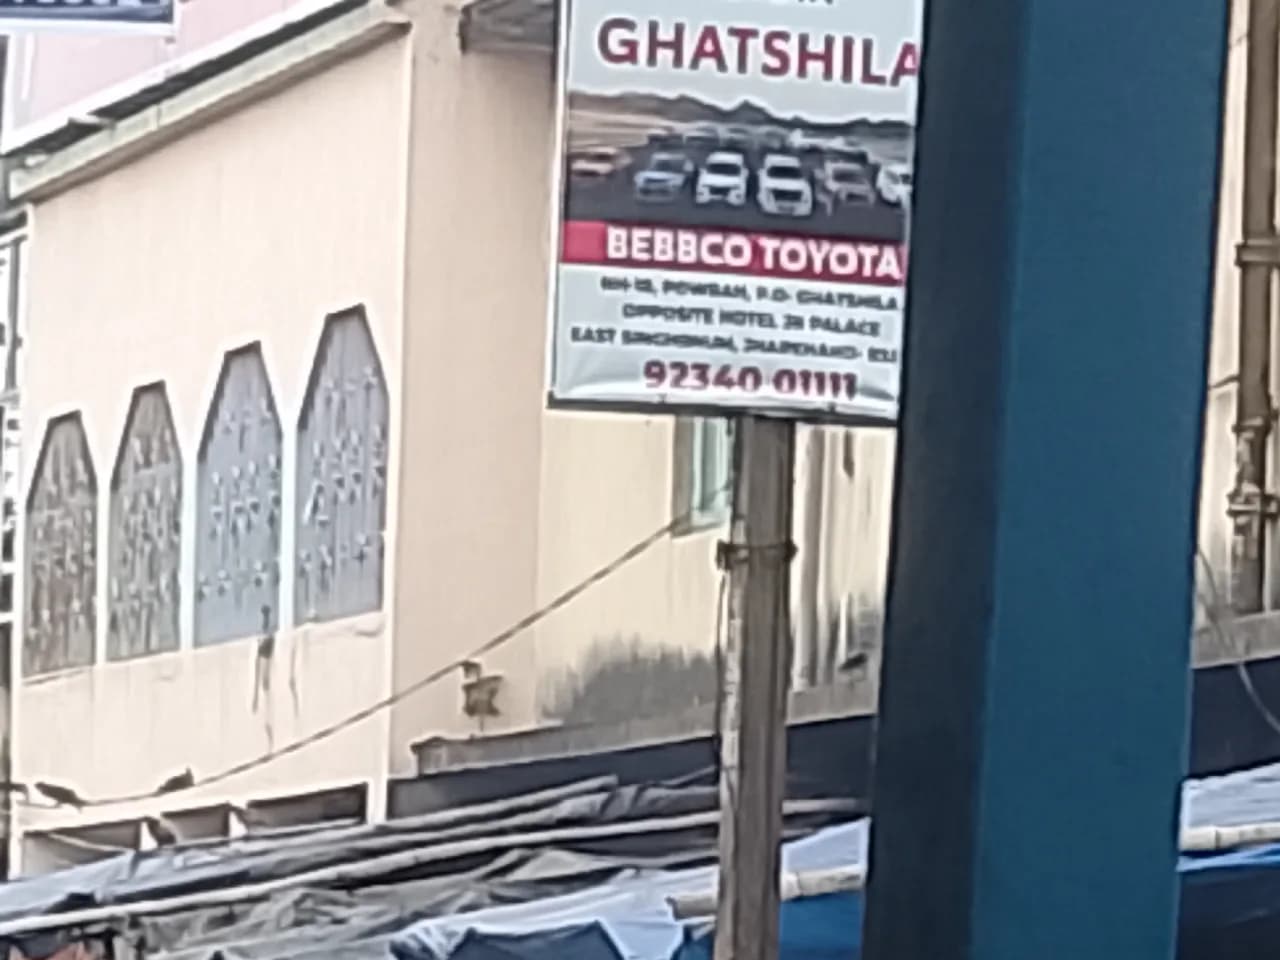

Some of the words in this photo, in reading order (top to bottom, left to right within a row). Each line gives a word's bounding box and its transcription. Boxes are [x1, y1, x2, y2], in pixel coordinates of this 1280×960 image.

[597, 17, 918, 87] GHATSHILA
[606, 226, 752, 268] BEBBCO
[757, 236, 904, 280] TOYOTA
[643, 359, 763, 393] 92340
